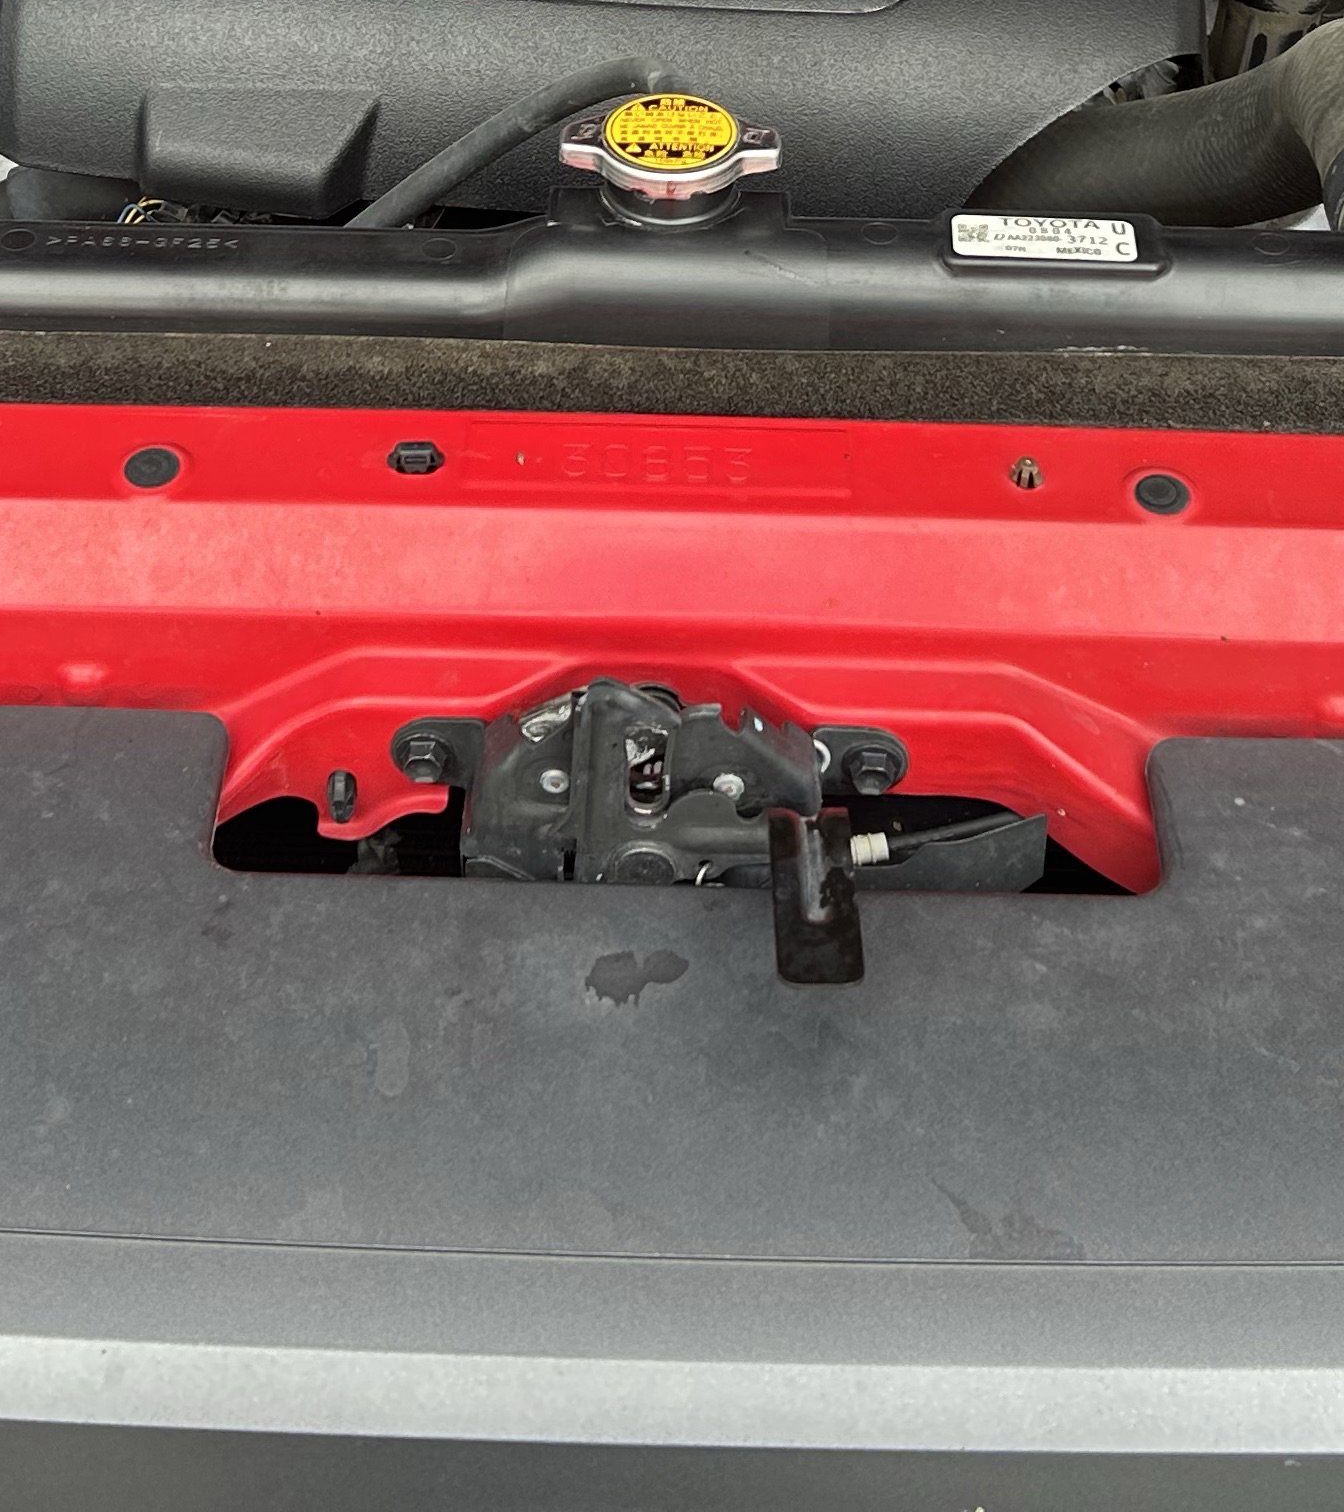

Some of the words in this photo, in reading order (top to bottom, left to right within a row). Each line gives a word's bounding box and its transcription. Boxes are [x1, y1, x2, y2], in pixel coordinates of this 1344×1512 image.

[648, 104, 709, 112] CAUTION
[649, 142, 716, 153] ATTENTION
[999, 217, 1101, 230] TOYOTA
[1111, 222, 1127, 236] U
[1056, 246, 1102, 256] MEXICO
[1115, 241, 1131, 256] C
